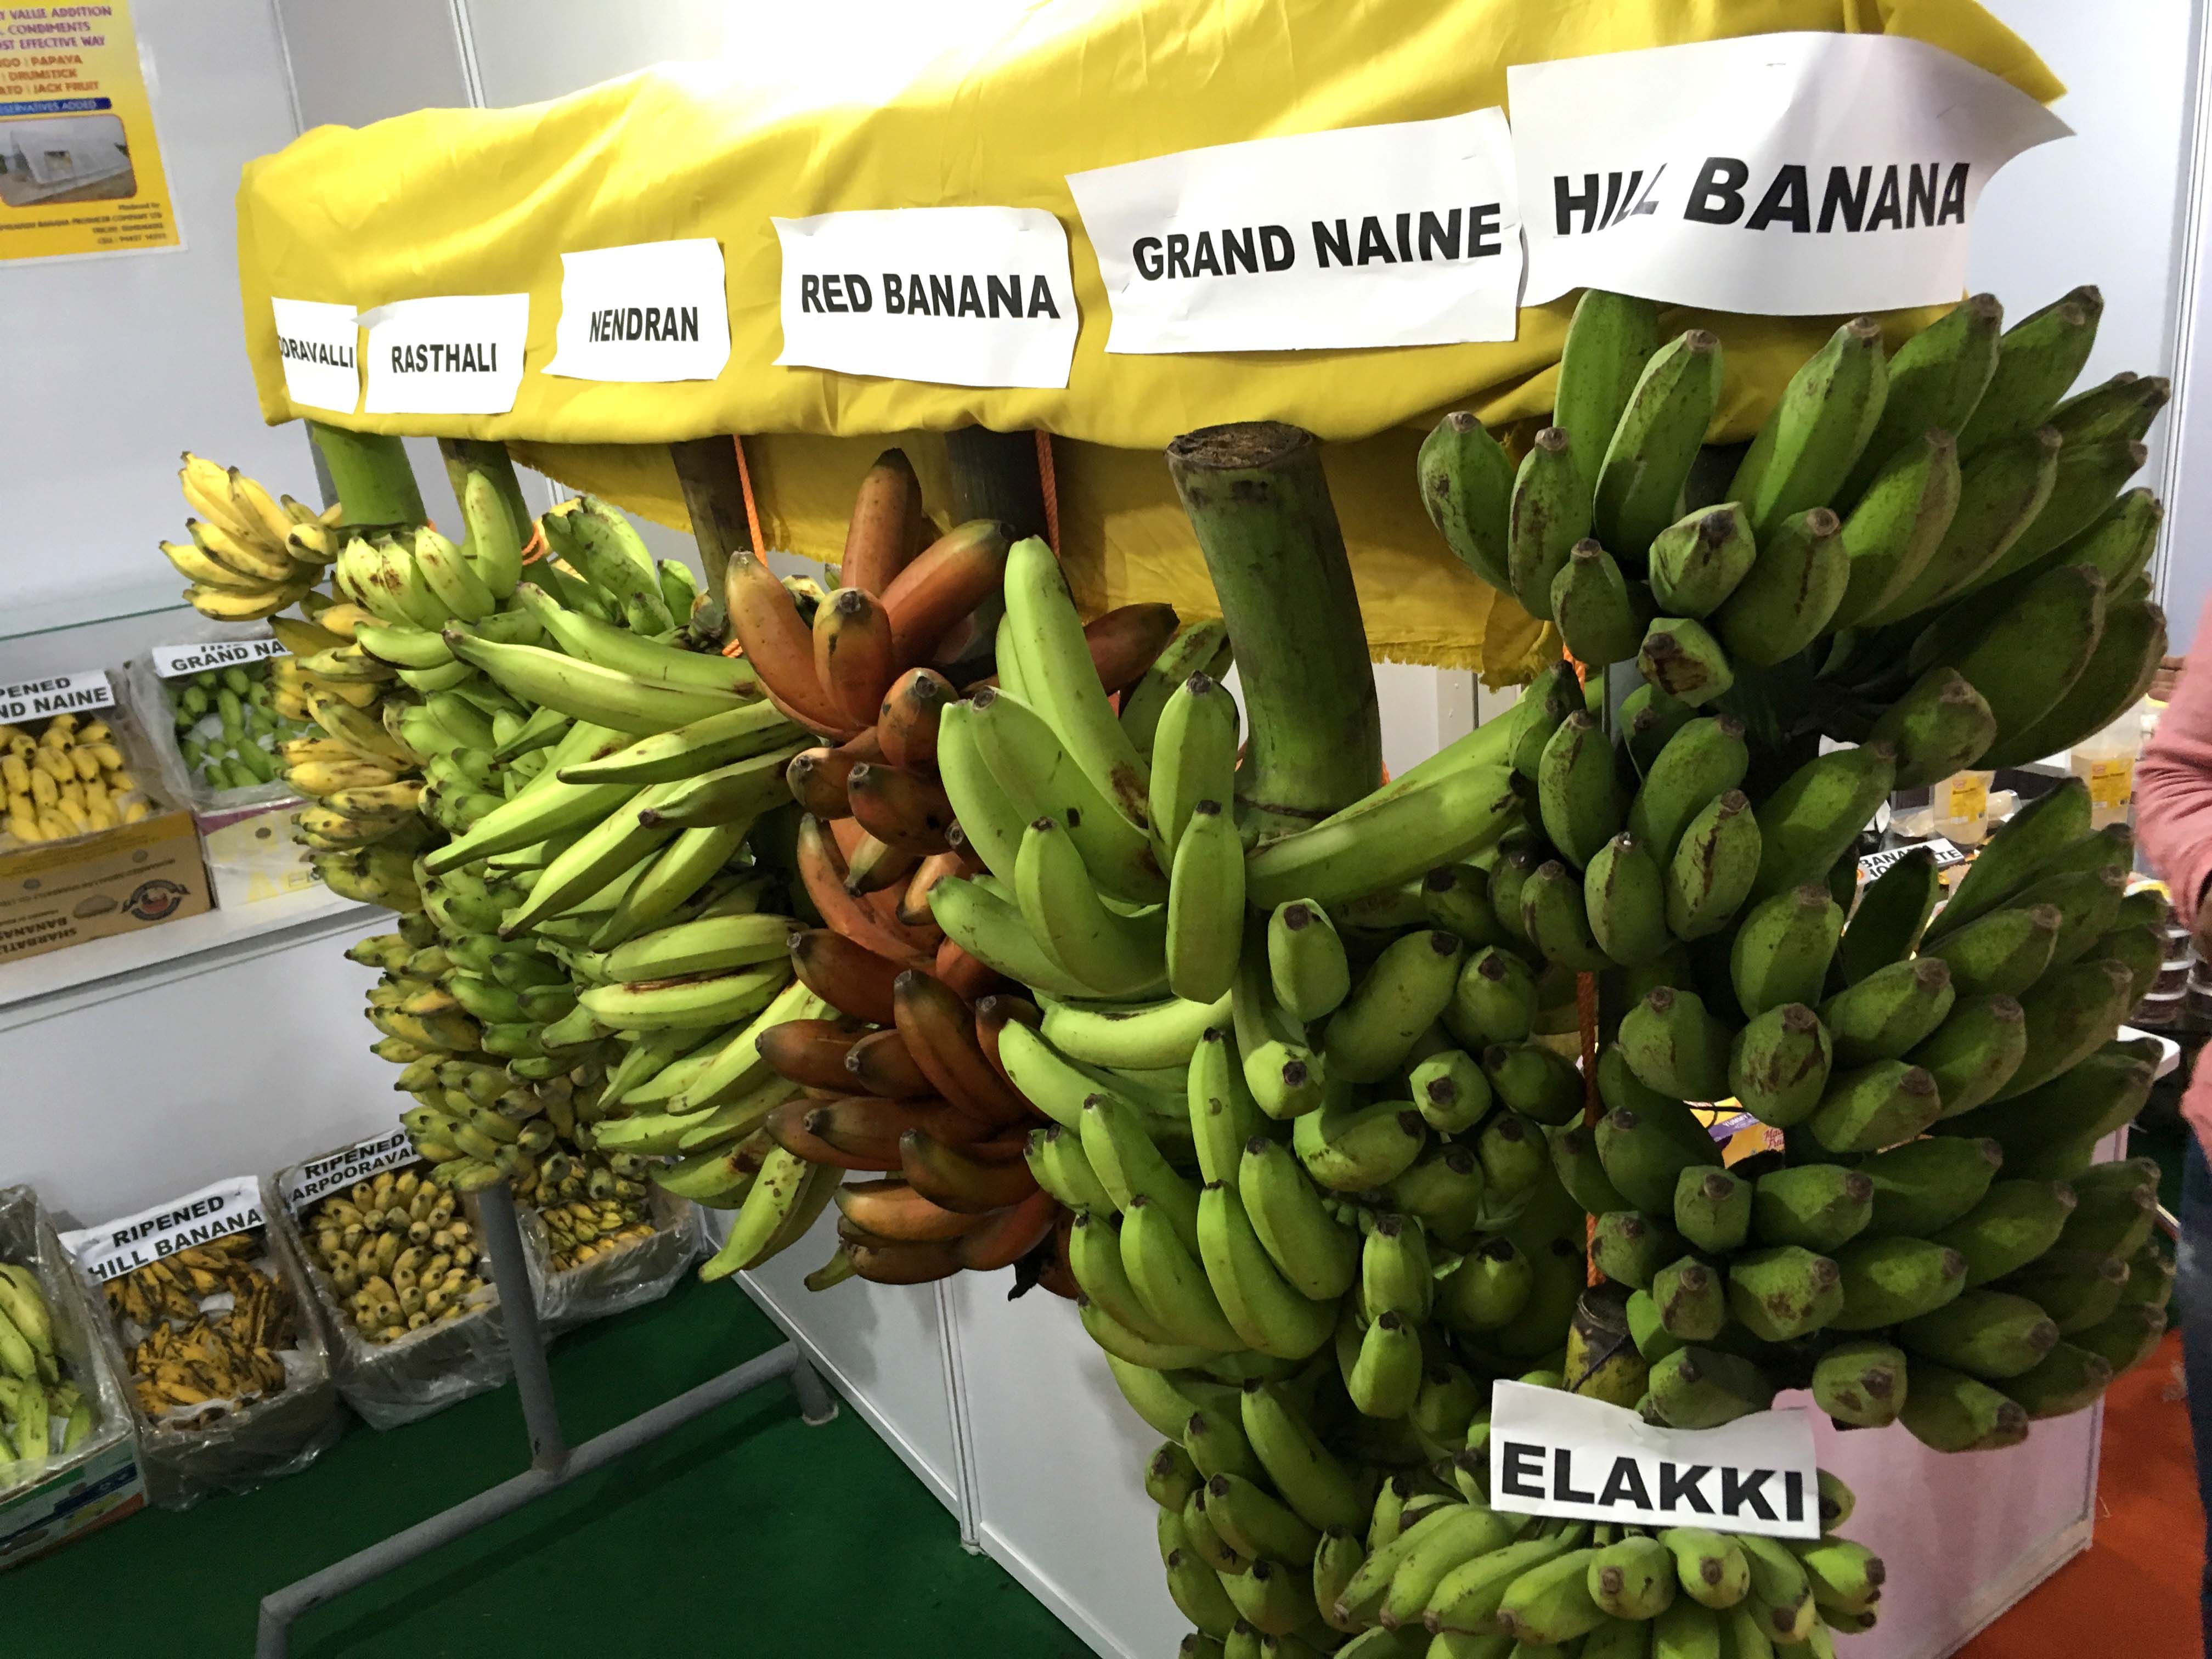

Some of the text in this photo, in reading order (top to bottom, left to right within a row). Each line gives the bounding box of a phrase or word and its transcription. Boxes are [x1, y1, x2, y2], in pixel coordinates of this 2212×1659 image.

[8, 21, 91, 35] CONDIMENTS
[9, 8, 47, 20] VALUE
[52, 6, 112, 18] ADDITION
[19, 37, 78, 49] EFFECTIVE
[81, 35, 105, 46] WAY
[8, 69, 77, 81] DRUMSTICK
[31, 54, 83, 66] PAPAYA
[33, 83, 63, 94] JACK
[65, 81, 99, 91] FRUIT
[1553, 156, 1970, 235] HILL BANANA
[1132, 202, 1502, 281] GRAND NAINE
[801, 273, 1061, 319] RED BANANA
[589, 306, 699, 343] NENDRAN
[391, 343, 498, 374] RASTHALI
[171, 647, 249, 672] GRAND
[253, 640, 286, 656] NA
[33, 687, 109, 713] NAINE
[304, 1133, 405, 1180] RIPENED
[292, 1147, 416, 1203] ARPOORAVA
[112, 1196, 225, 1248] RIPENED
[88, 1208, 263, 1279] HILL BANANA
[1500, 1441, 1804, 1522] ELAKKI
